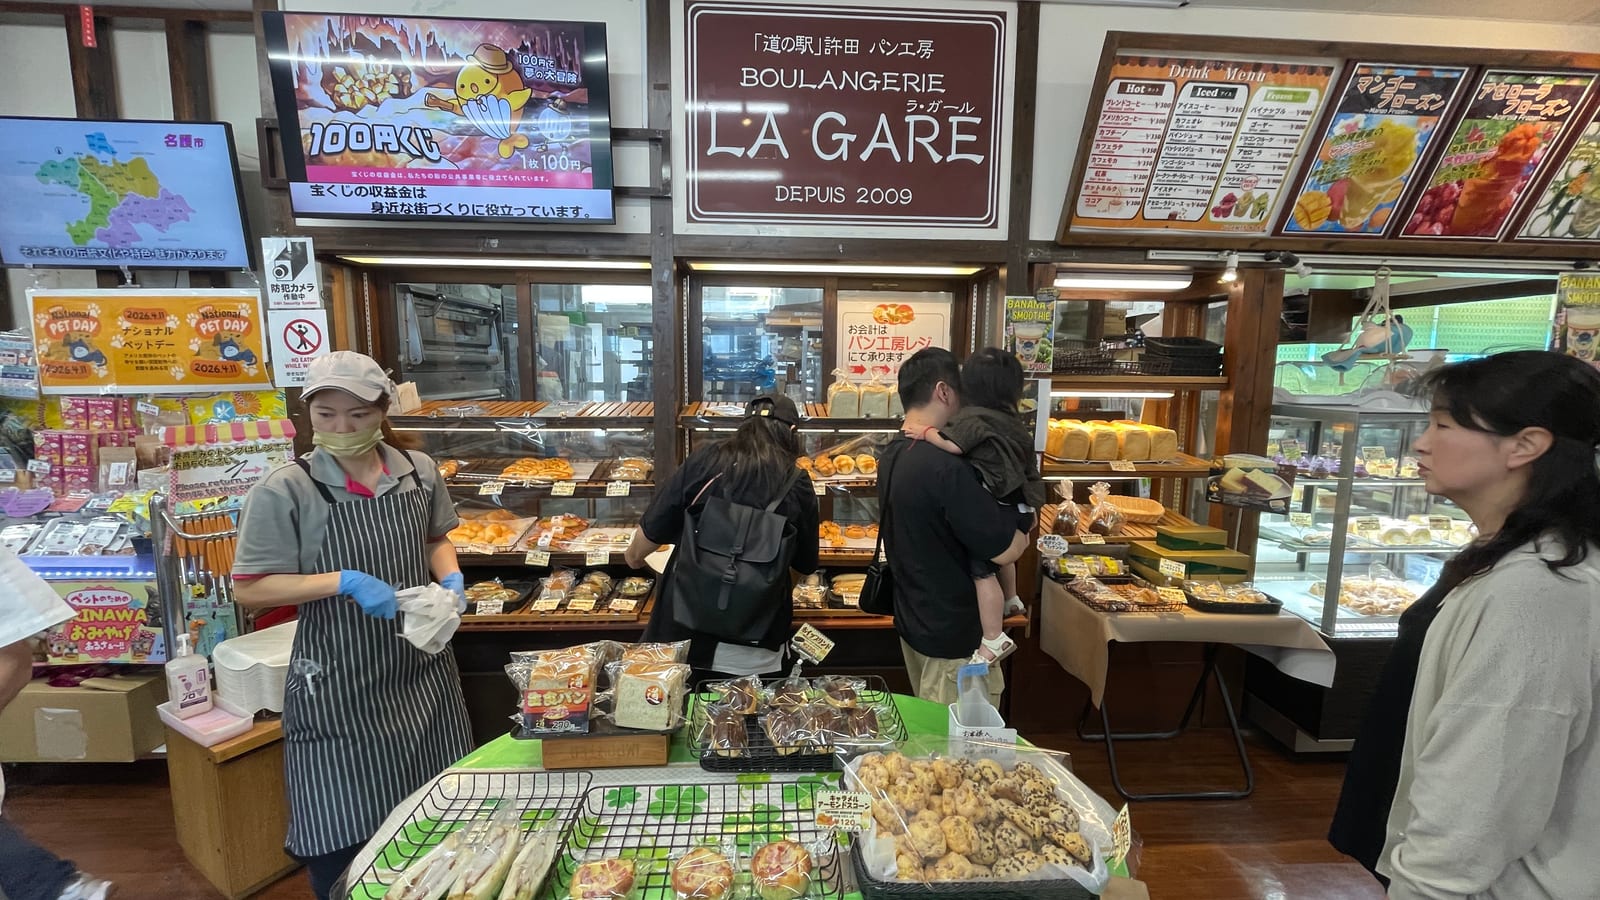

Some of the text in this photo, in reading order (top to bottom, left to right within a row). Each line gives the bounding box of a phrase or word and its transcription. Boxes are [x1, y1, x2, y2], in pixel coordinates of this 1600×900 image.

[754, 32, 934, 59] 「道の駅」許田 パン工房
[517, 53, 554, 69] 100円で
[523, 67, 578, 84] 夢の大冒険
[1169, 64, 1266, 82] Drink Menu
[740, 67, 946, 94] BOULANGERIE
[1357, 75, 1416, 94] マンゴー
[1125, 84, 1146, 94] Hot
[1196, 87, 1219, 97] Iced
[1478, 82, 1553, 101] アセローラ
[906, 100, 975, 114] ラ・ガール
[1177, 102, 1216, 110] アイスコーヒー
[1377, 93, 1446, 111] フローズン
[1503, 99, 1571, 117] フローズン
[164, 134, 204, 148] 名護市
[310, 122, 442, 162] 100円くじ
[706, 108, 985, 165] LA GARE
[521, 154, 581, 171] 1枚100円
[310, 184, 427, 199] 宝くじの収益金は
[774, 185, 913, 205] DEPUIS 2009
[371, 201, 592, 218] 身近な街づくりに役立っています。
[271, 283, 315, 293] 防犯カメラ
[1007, 299, 1046, 309] BANANA
[127, 311, 165, 320] 2026.4.11
[201, 310, 241, 320] National
[1012, 311, 1050, 320] SMOOTHIE
[49, 319, 98, 335] PET DAY
[122, 326, 174, 336] ナショナル
[200, 319, 248, 334] PET DAY
[848, 324, 888, 335] お会計は
[123, 340, 175, 350] ペットデー
[848, 336, 933, 350] パン工房レジ
[848, 351, 904, 362] にて承ります
[194, 363, 238, 374] 2026.4.11
[176, 480, 206, 492] Please
[208, 478, 240, 487] return
[177, 488, 205, 498] tongs
[206, 487, 216, 496] to
[219, 485, 239, 494] the
[70, 593, 129, 604] ペットのための
[70, 625, 135, 641] おみやげ
[818, 801, 870, 810] アーモンドスコーン
[834, 818, 855, 826] ¥120
